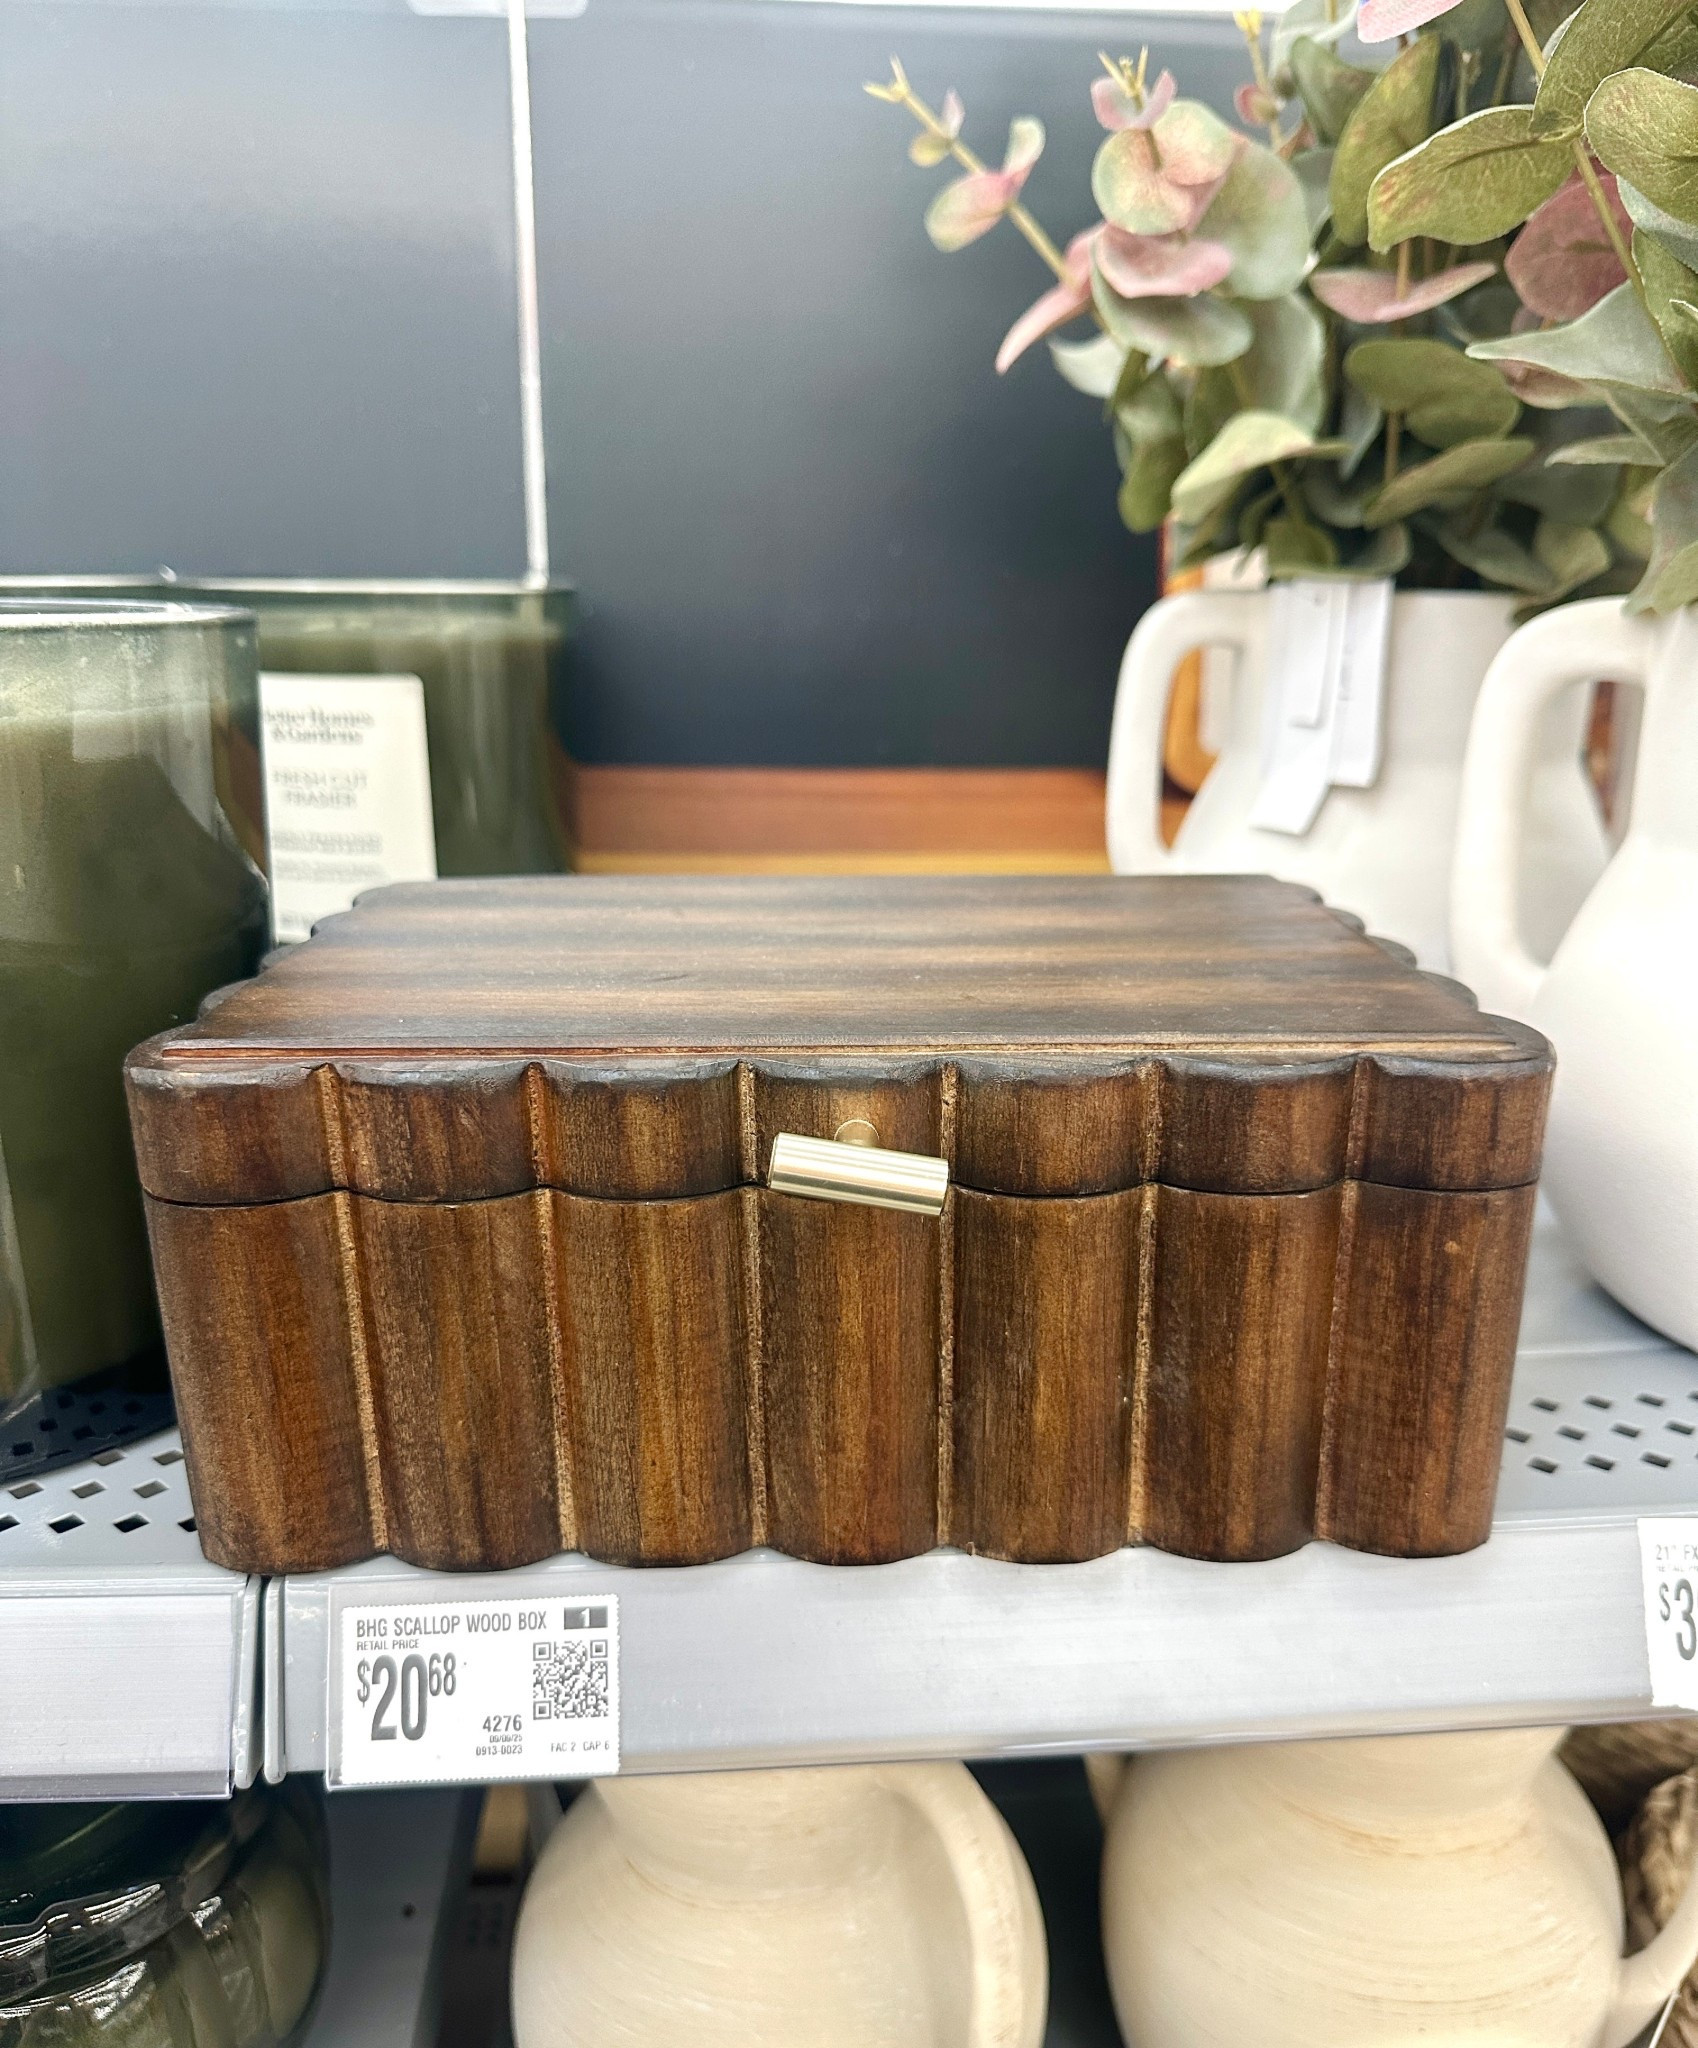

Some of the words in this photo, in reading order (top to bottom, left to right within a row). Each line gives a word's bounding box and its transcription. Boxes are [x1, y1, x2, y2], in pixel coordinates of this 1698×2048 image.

[356, 1619, 388, 1638] BHG
[393, 1615, 460, 1636] SCALLOP
[466, 1612, 511, 1633] WOOD
[518, 1610, 547, 1631] BOX
[580, 1607, 591, 1628] 1
[356, 1640, 389, 1651] RETAIL
[392, 1638, 420, 1650] PRICE
[482, 1714, 523, 1733] 4276
[475, 1744, 523, 1756] 0913-0023
[550, 1742, 568, 1752] FAC
[570, 1741, 576, 1752] 2
[583, 1740, 602, 1751] CAP
